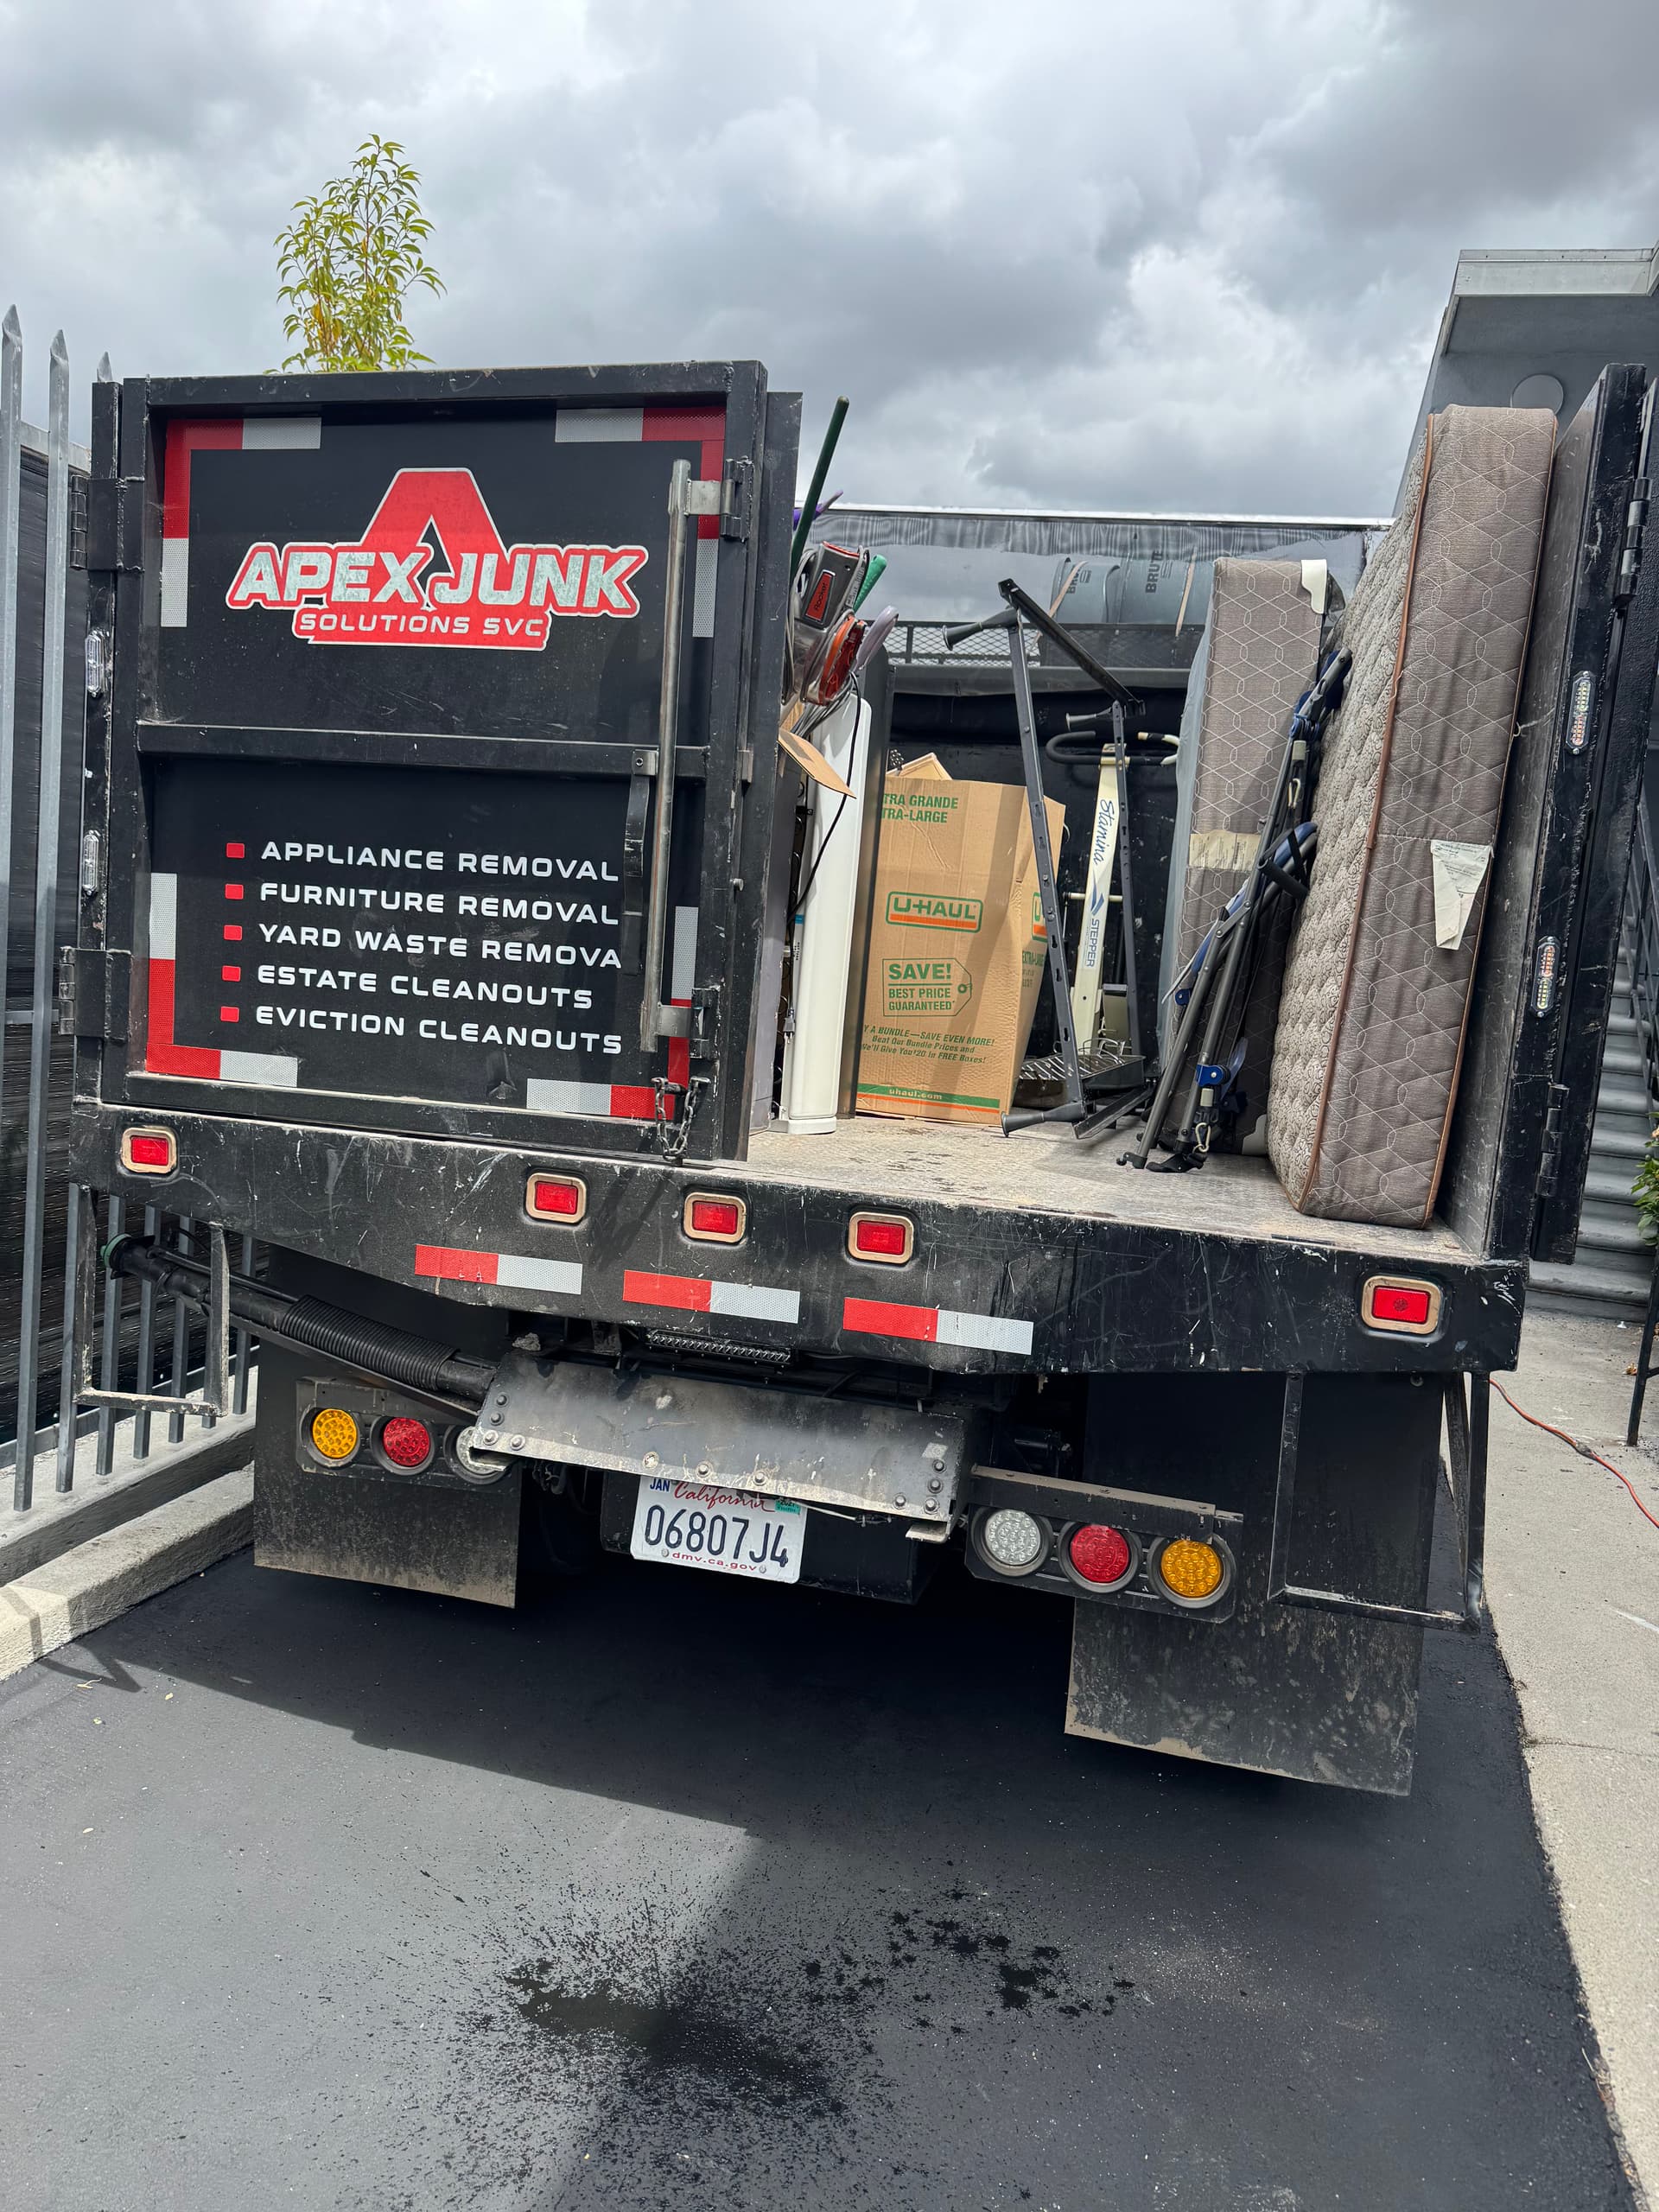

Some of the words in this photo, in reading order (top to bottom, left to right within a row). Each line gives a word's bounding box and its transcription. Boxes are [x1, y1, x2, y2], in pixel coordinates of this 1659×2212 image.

[232, 550, 432, 603] APEX
[434, 553, 641, 608] JUNK
[1145, 550, 1164, 594] BRUTE
[299, 613, 470, 634] SOLUTIONS
[482, 617, 543, 637] SVC
[881, 808, 948, 823] TRA-LARGE
[883, 793, 906, 805] TRA
[909, 795, 958, 809] GRANDE
[1093, 798, 1115, 865] Stamina
[261, 841, 444, 871] APPLIANCE
[458, 852, 620, 882] REMOVAL
[259, 882, 444, 913] FURNITURE
[458, 895, 620, 925] REMOVAL
[893, 897, 976, 920] U-HAUL
[258, 924, 341, 948] YARD
[354, 930, 467, 957] WASTE
[481, 939, 622, 969] REMOVA
[1085, 918, 1100, 967] STEPPER
[257, 963, 378, 993] ESTATE
[390, 975, 594, 1010] CLEANOUTS
[887, 963, 951, 980] SAVE!
[887, 988, 915, 999] BEST
[918, 988, 950, 999] PRICE
[256, 1005, 405, 1036] EVICTION
[418, 1018, 623, 1055] CLEANOUTS
[872, 1035, 890, 1044] Beat
[891, 1037, 904, 1046] Our
[906, 1039, 932, 1049] Bundle
[933, 1042, 958, 1052] Prices
[943, 1033, 966, 1044] EVEN
[966, 1036, 995, 1046] MORE!
[880, 1045, 897, 1053] Give
[938, 1052, 957, 1061] FREE
[959, 1055, 987, 1065] Boxes!
[888, 1087, 943, 1100] uhaul.com
[649, 1477, 671, 1493] JAN
[674, 1480, 776, 1513] California
[645, 1504, 789, 1568] 06807J4
[671, 1552, 758, 1572] dmv.ca.gov
